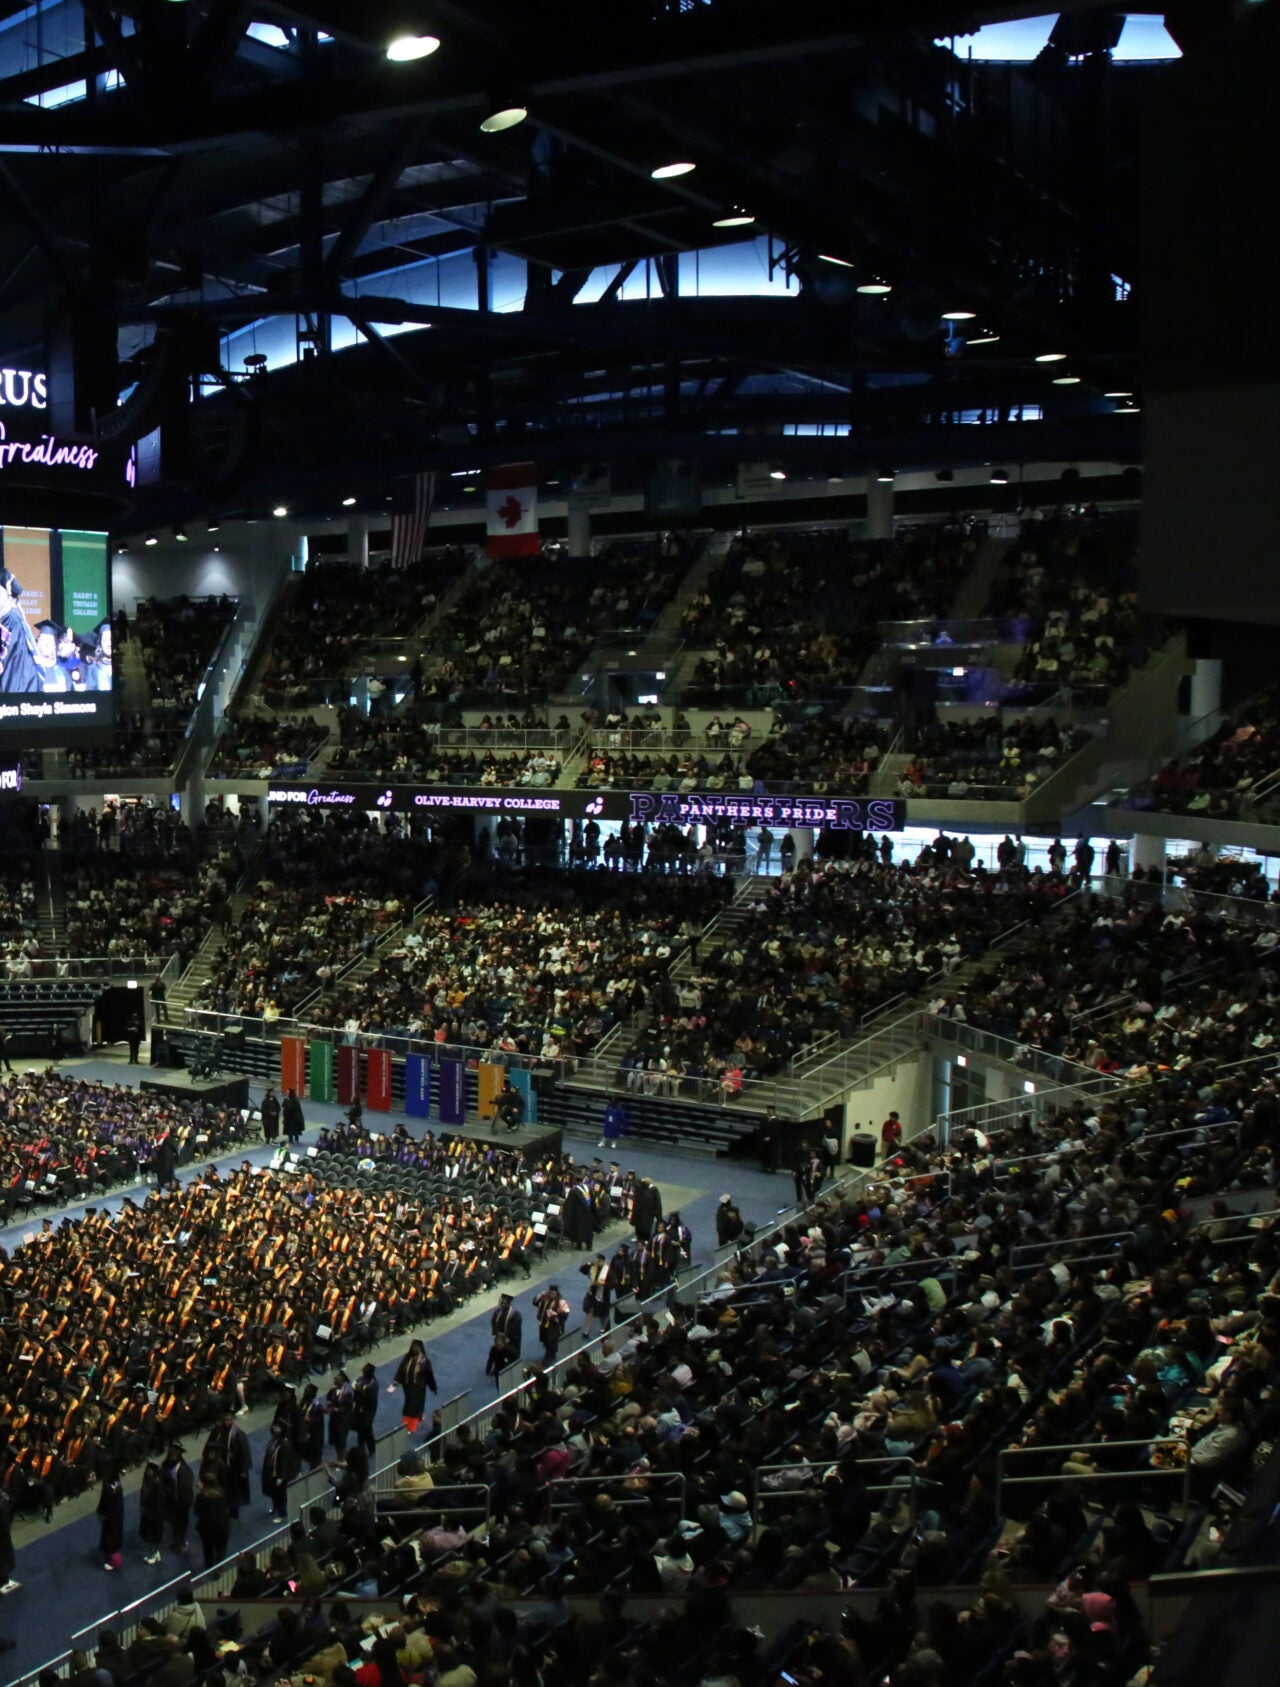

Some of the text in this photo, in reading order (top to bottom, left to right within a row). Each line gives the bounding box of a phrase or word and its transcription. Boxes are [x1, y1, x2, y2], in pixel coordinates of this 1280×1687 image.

[73, 608, 98, 616] COLLEGE
[20, 703, 53, 718] Shayla
[53, 701, 97, 714] Simmons
[287, 790, 307, 801] FOR
[414, 795, 560, 810] OLIVE-HARVEY COLLEGE
[680, 804, 837, 820] PANTHERS PRIDE
